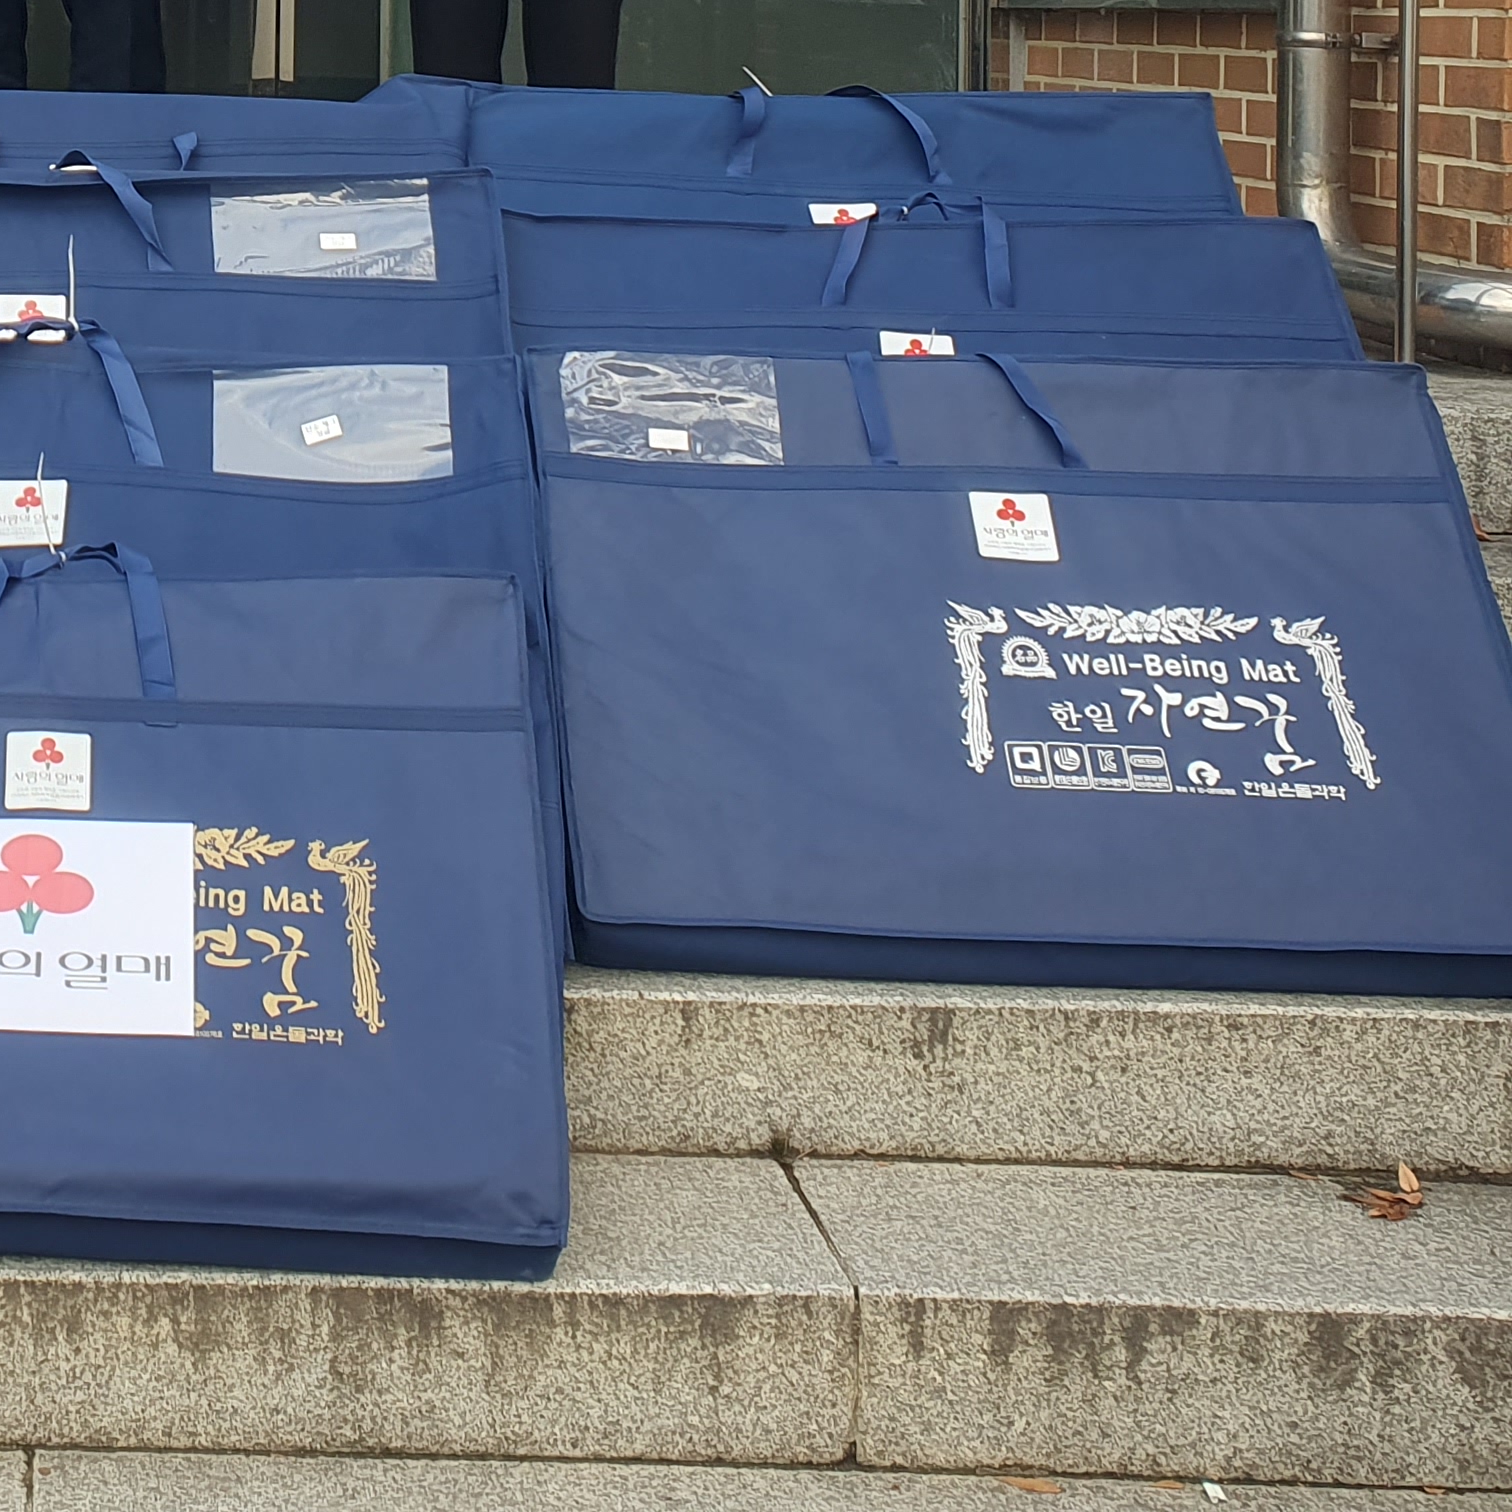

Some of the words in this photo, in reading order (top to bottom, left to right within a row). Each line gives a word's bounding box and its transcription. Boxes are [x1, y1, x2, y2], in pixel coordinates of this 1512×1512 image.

[982, 526, 1019, 539] 사랑의
[1021, 528, 1049, 541] 열매
[1061, 652, 1229, 685] Well-Being
[1240, 657, 1301, 683] Mat
[1048, 700, 1119, 733] 한일
[12, 771, 52, 785] 사랑의
[54, 772, 84, 786] 열매
[1242, 780, 1346, 801] 한일온돌과학
[194, 880, 246, 916] ing
[263, 885, 325, 914] Mat
[57, 951, 173, 990] 열매
[232, 1022, 345, 1047] 한일온돌과학
